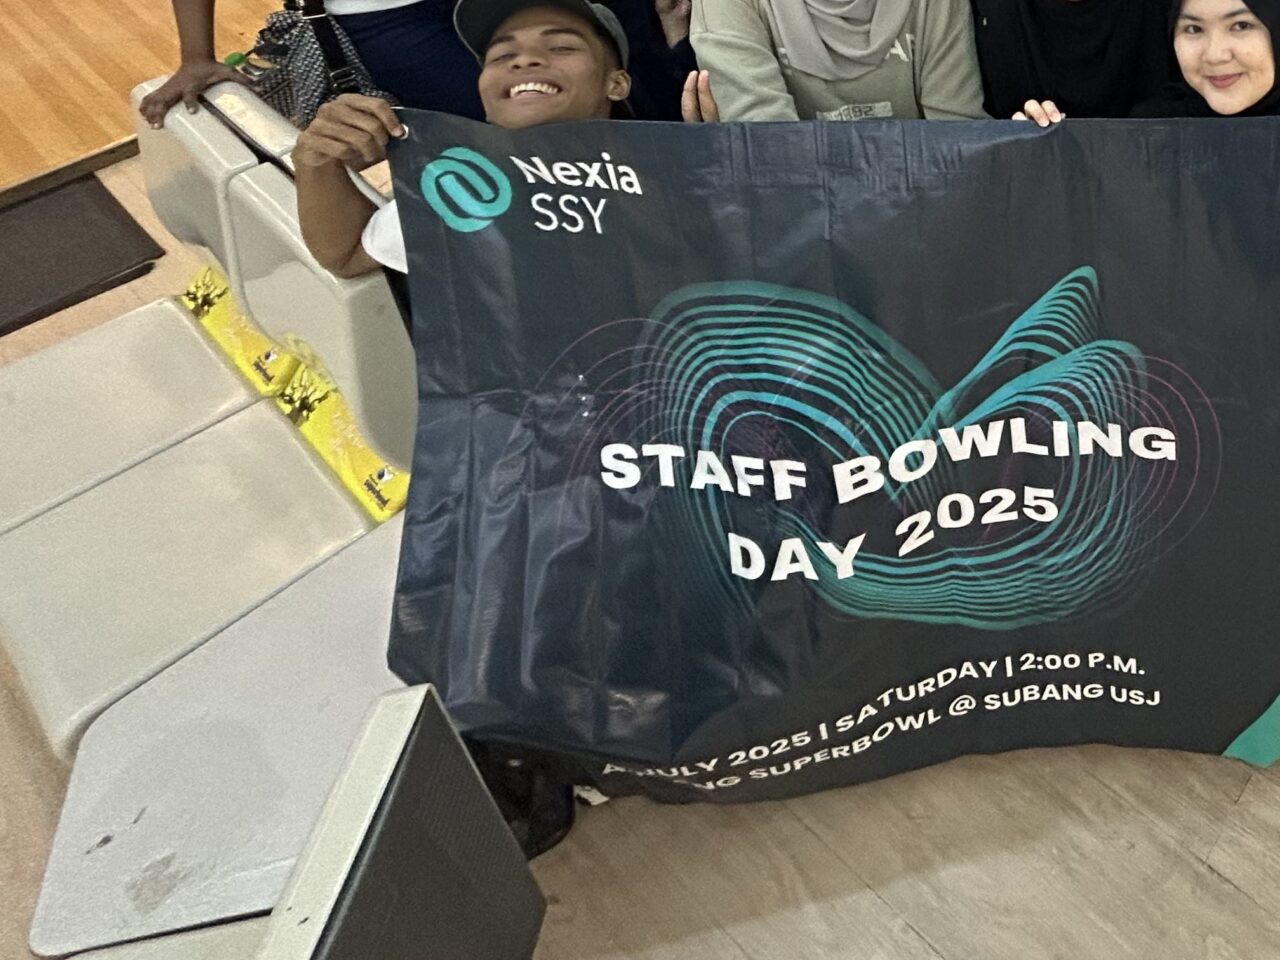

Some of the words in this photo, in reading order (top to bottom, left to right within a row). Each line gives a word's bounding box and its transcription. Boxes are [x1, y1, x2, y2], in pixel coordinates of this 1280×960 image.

[509, 152, 643, 195] Nexia
[531, 192, 607, 234] SSY
[600, 443, 807, 501] STAFF
[832, 417, 1177, 503] BOWLING
[728, 532, 866, 582] DAY
[895, 486, 1059, 556] 2025
[727, 730, 812, 766] 2025
[835, 660, 998, 732] SATURDAY
[1019, 653, 1080, 671] 2:00
[1088, 652, 1146, 675] P.M.
[748, 709, 941, 779] SUPERBOWL
[948, 695, 976, 716] @
[983, 684, 1104, 711] SUBANG
[1109, 685, 1161, 706] USJ
